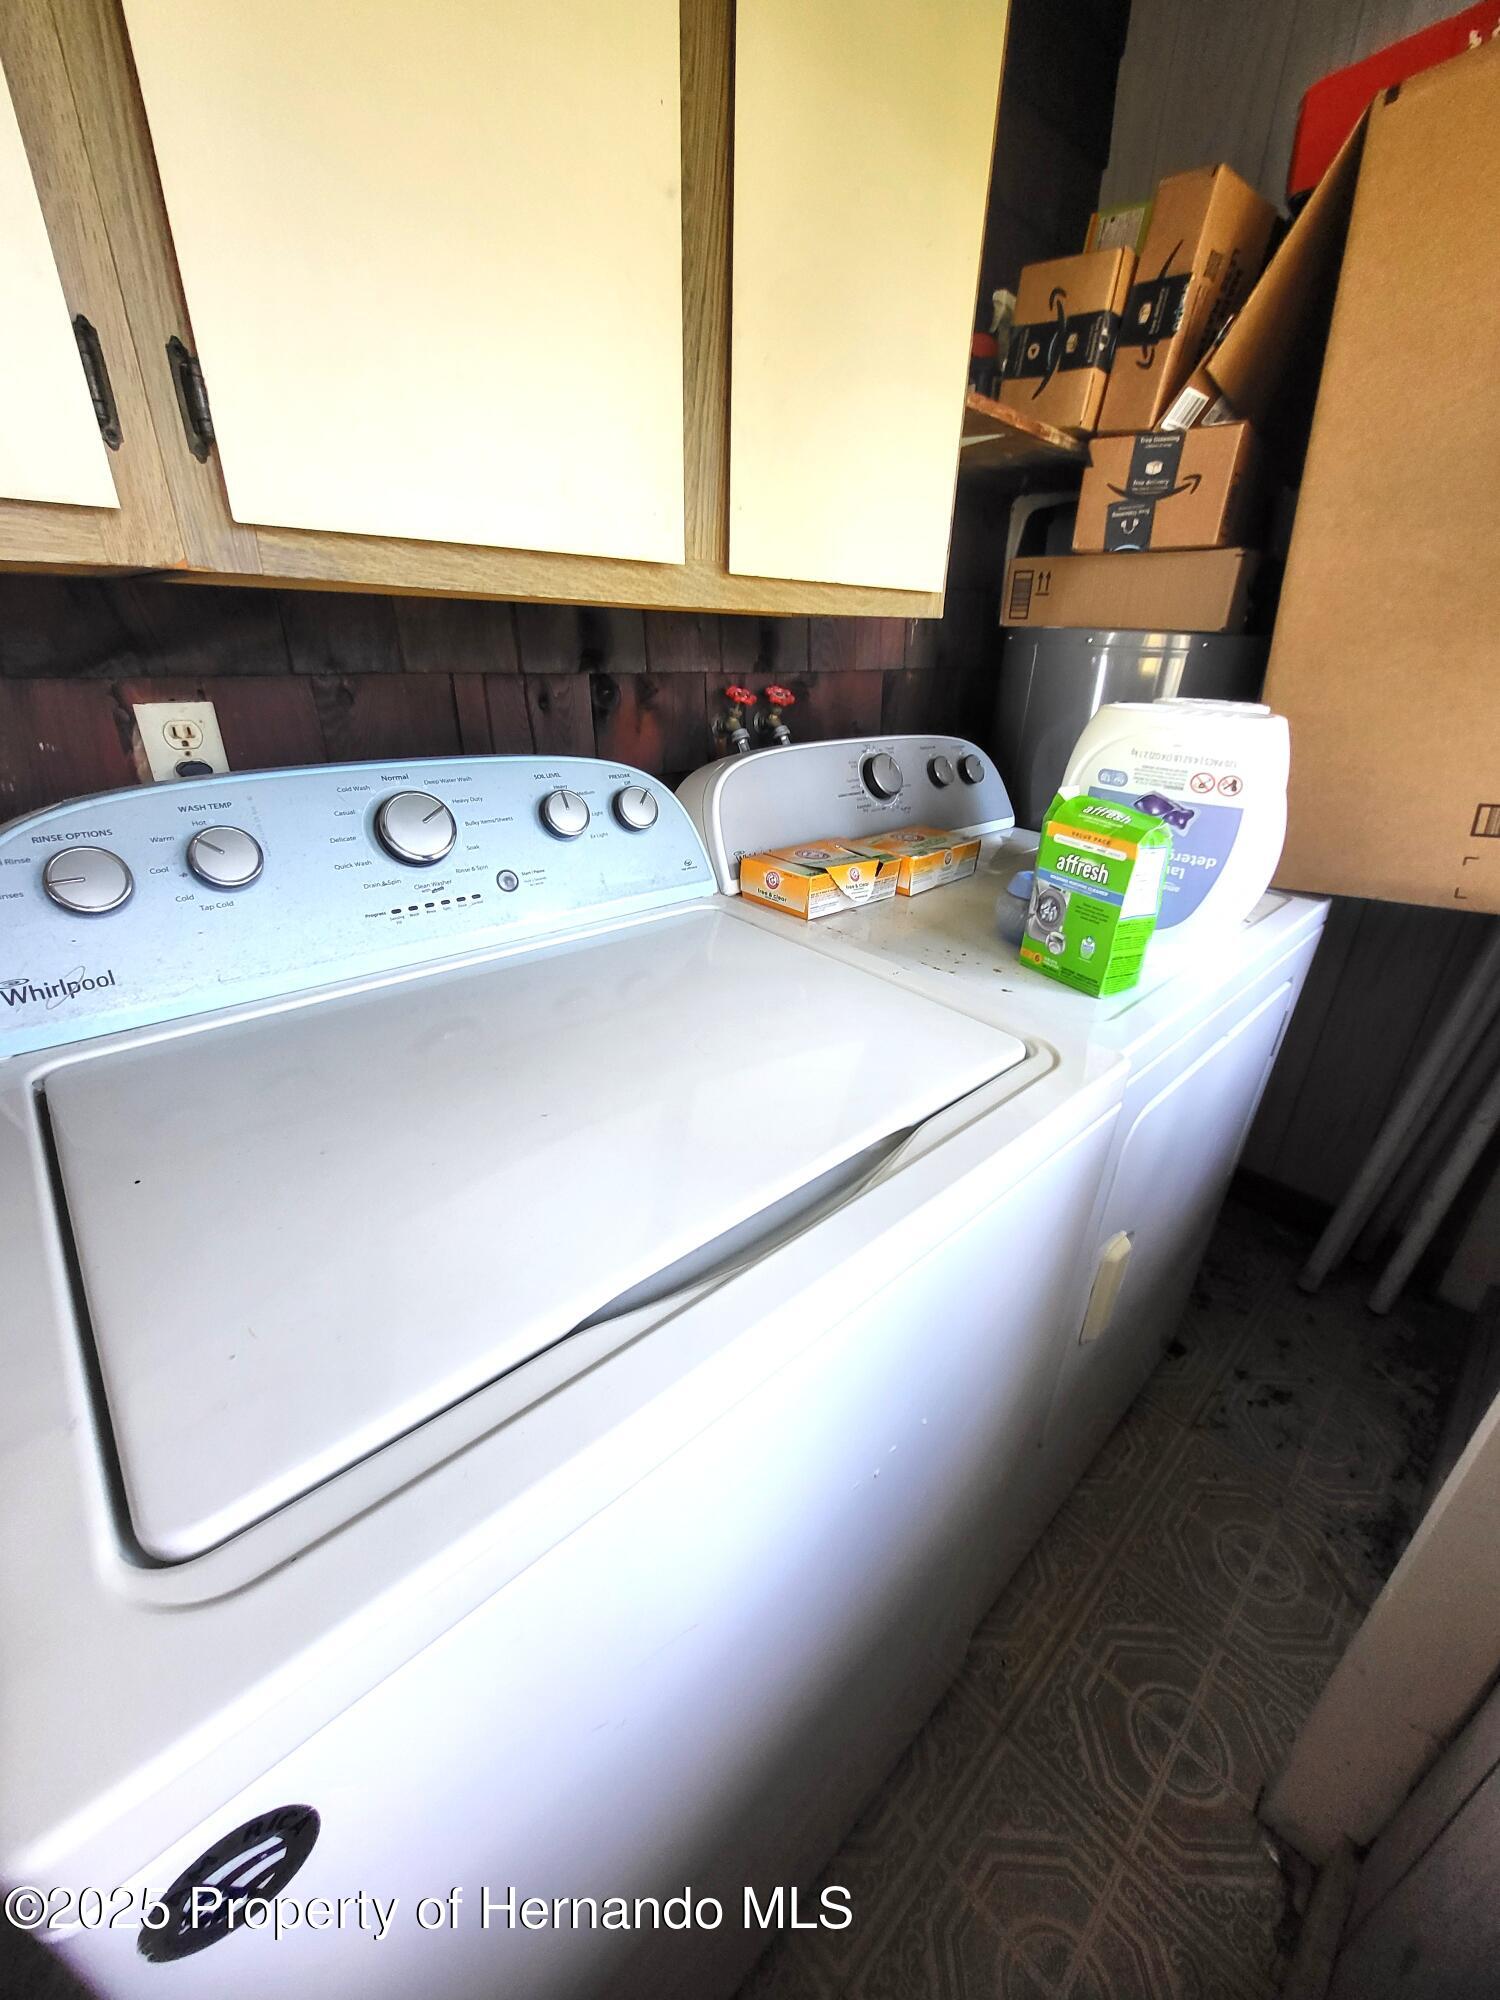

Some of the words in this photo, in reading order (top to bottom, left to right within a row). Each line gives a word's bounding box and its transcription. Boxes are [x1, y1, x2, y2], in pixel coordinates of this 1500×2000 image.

[381, 774, 410, 782] Normal
[353, 784, 370, 792] Wash
[177, 803, 206, 814] WASH
[208, 801, 232, 812] TEMP
[334, 809, 356, 817] Casual
[1082, 806, 1132, 824] affresh
[32, 831, 64, 844] RINSE
[65, 828, 113, 841] OPTIONS
[150, 835, 175, 844] Warm
[330, 835, 357, 844] Delicate
[4, 858, 31, 866] Rinse
[150, 866, 170, 875] Cool
[1056, 854, 1109, 884] affresh
[0, 892, 24, 900] nses
[175, 894, 195, 903] Cold
[200, 904, 214, 912] Tap
[216, 901, 234, 910] Cold
[0, 970, 116, 1006] Whirlpool
